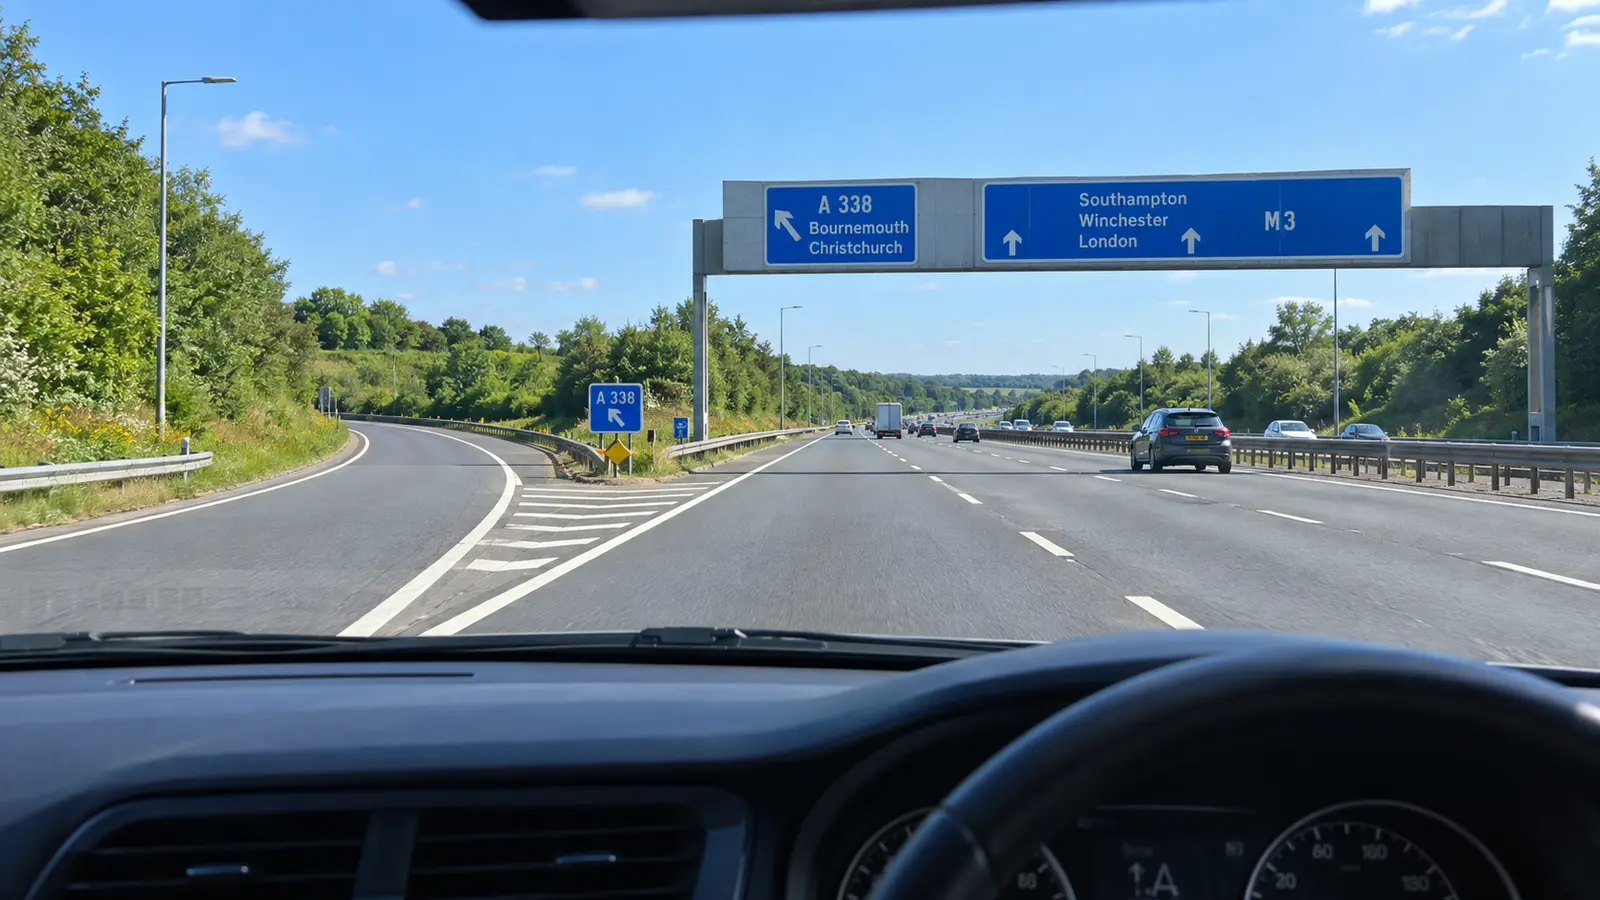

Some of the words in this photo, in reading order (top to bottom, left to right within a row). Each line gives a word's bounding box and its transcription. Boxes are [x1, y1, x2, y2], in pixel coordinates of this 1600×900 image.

[818, 195, 831, 214] A
[838, 194, 872, 213] 338
[1079, 191, 1187, 208] Southampton
[809, 220, 909, 235] Bournemouth
[1079, 213, 1168, 227] Winchester
[809, 240, 902, 255] Christchurch
[1079, 233, 1137, 248] London
[596, 391, 606, 405] A
[610, 391, 635, 405] 338
[1275, 872, 1297, 890] 20
